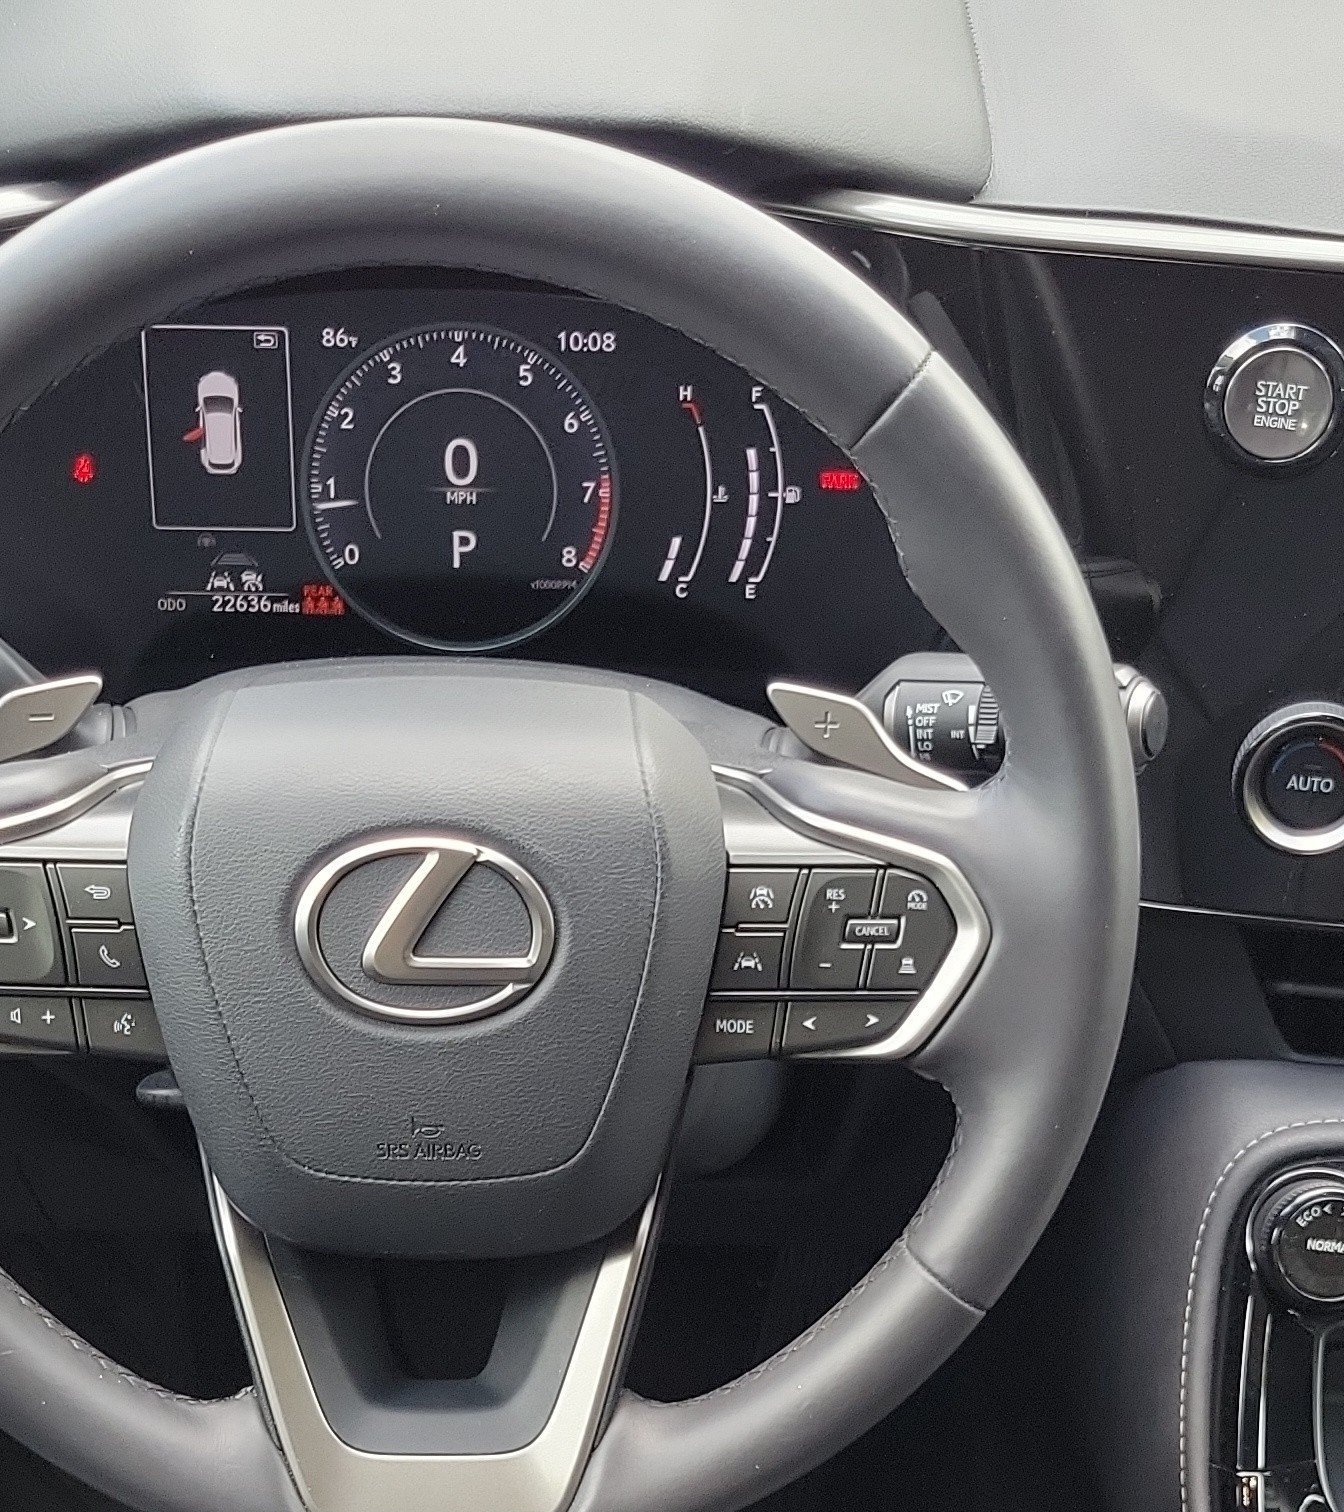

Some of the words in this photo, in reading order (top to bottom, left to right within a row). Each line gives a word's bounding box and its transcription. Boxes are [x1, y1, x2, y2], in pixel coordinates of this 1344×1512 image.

[557, 331, 616, 352] 10:08
[450, 345, 467, 367] 4
[387, 362, 402, 384] 3
[519, 365, 533, 387] 5
[679, 385, 692, 401] H
[752, 386, 763, 402] F
[1255, 381, 1310, 401] START
[1256, 397, 1299, 416] STOP
[340, 408, 354, 429] 2
[563, 412, 578, 433] 6
[1254, 414, 1297, 431] ENGINE
[444, 438, 478, 486] 0
[325, 477, 336, 498] 1
[581, 482, 596, 503] 7
[446, 491, 476, 505] MPH
[344, 544, 359, 565] 0
[452, 531, 477, 568] P
[562, 546, 577, 567] 8
[675, 584, 688, 598] C
[745, 584, 756, 598] E
[157, 599, 186, 611] ODO
[211, 596, 271, 613] 22636
[272, 600, 300, 613] miles
[916, 703, 941, 714] MIST
[916, 716, 937, 727] OFF
[916, 728, 933, 740] INT
[950, 730, 965, 739] INT
[1286, 773, 1334, 795] AUTO
[826, 889, 845, 901] RES
[855, 925, 890, 937] CANCEL
[715, 1019, 754, 1034] MODE
[376, 1142, 410, 1160] SRS
[413, 1142, 483, 1161] AIRBAG
[1296, 1205, 1322, 1228] ECO
